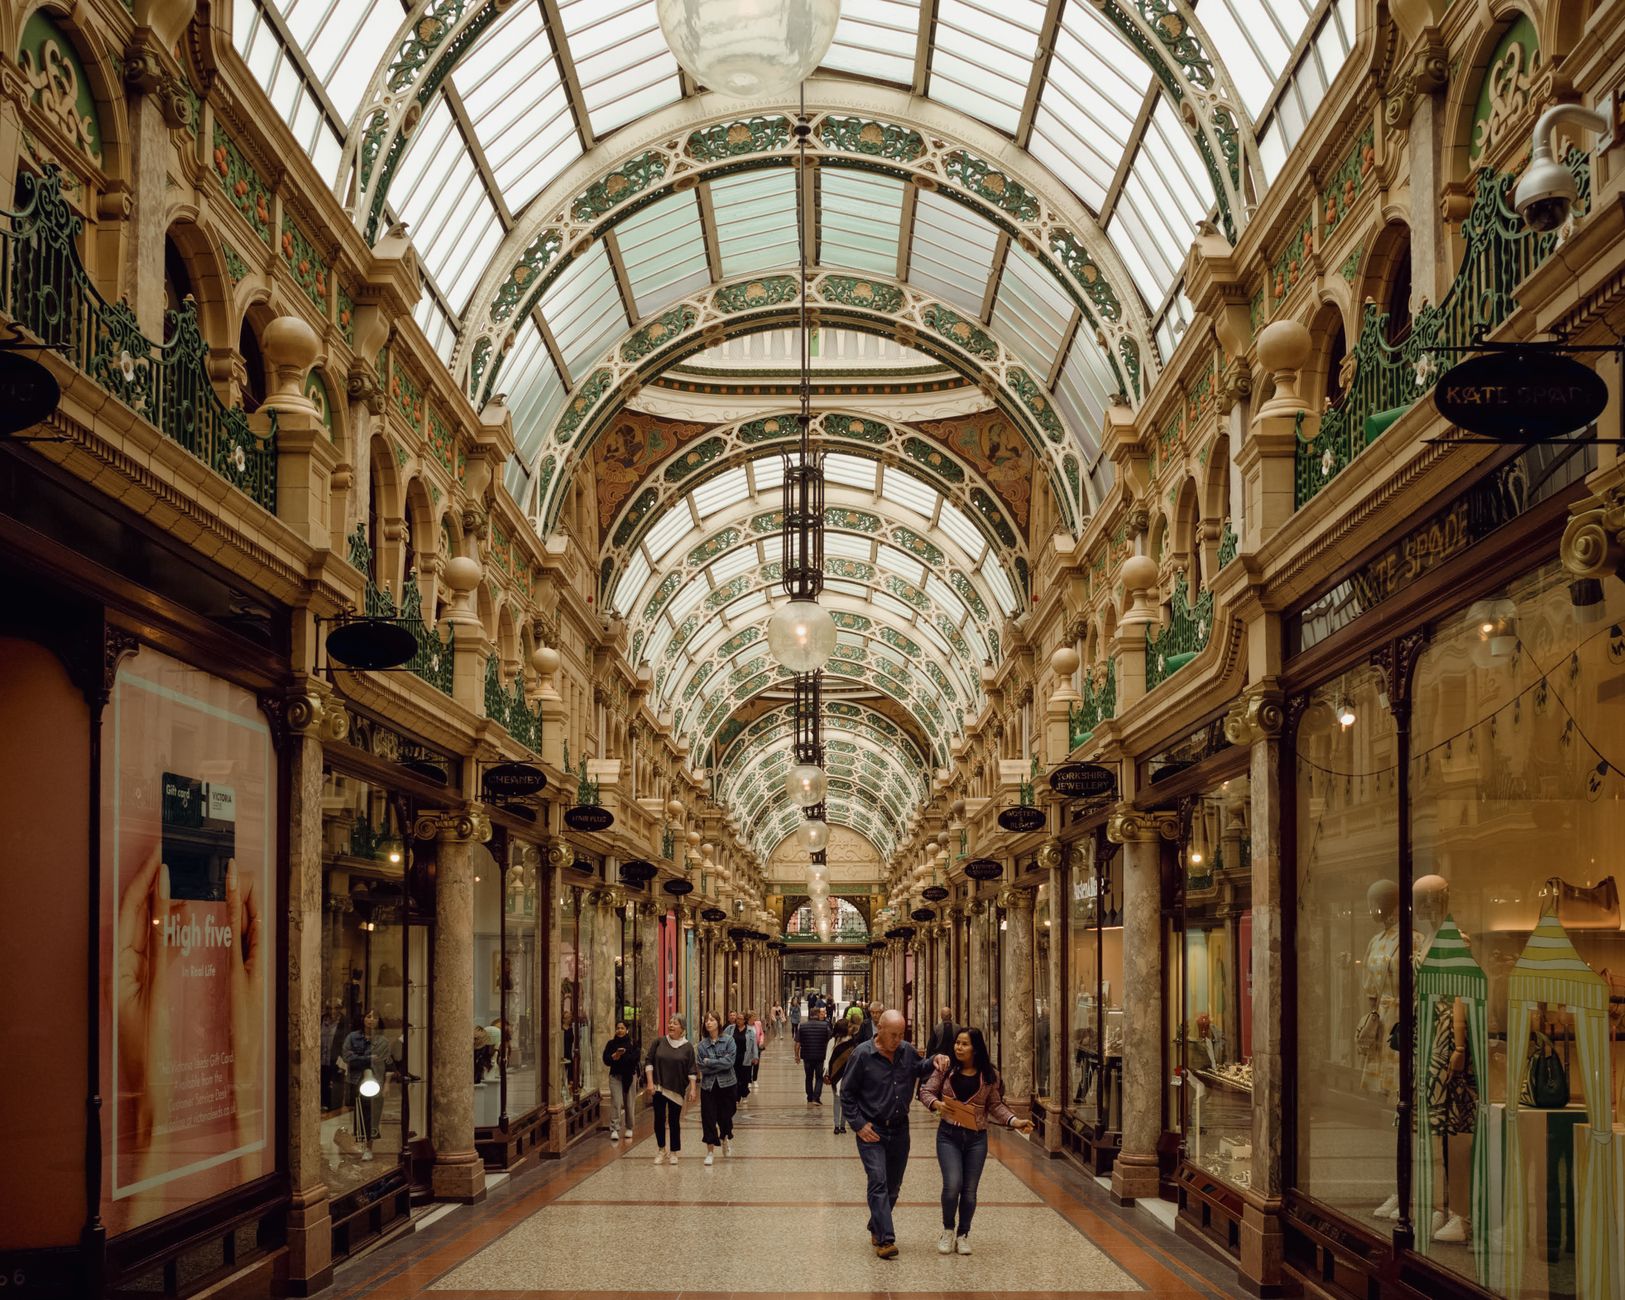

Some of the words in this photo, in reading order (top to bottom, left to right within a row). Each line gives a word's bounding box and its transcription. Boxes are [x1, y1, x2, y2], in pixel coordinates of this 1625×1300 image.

[1446, 386, 1509, 404] KATE
[1403, 501, 1469, 579] SPADE
[1056, 770, 1109, 780] YORKSHIRE
[166, 783, 177, 797] Gift
[1056, 781, 1109, 791] JEWELLERY
[211, 791, 232, 804] VICTORIA
[163, 913, 202, 957] High
[204, 913, 233, 948] five
[190, 962, 205, 977] Real
[204, 963, 216, 977] Life
[209, 1052, 220, 1067] Gift
